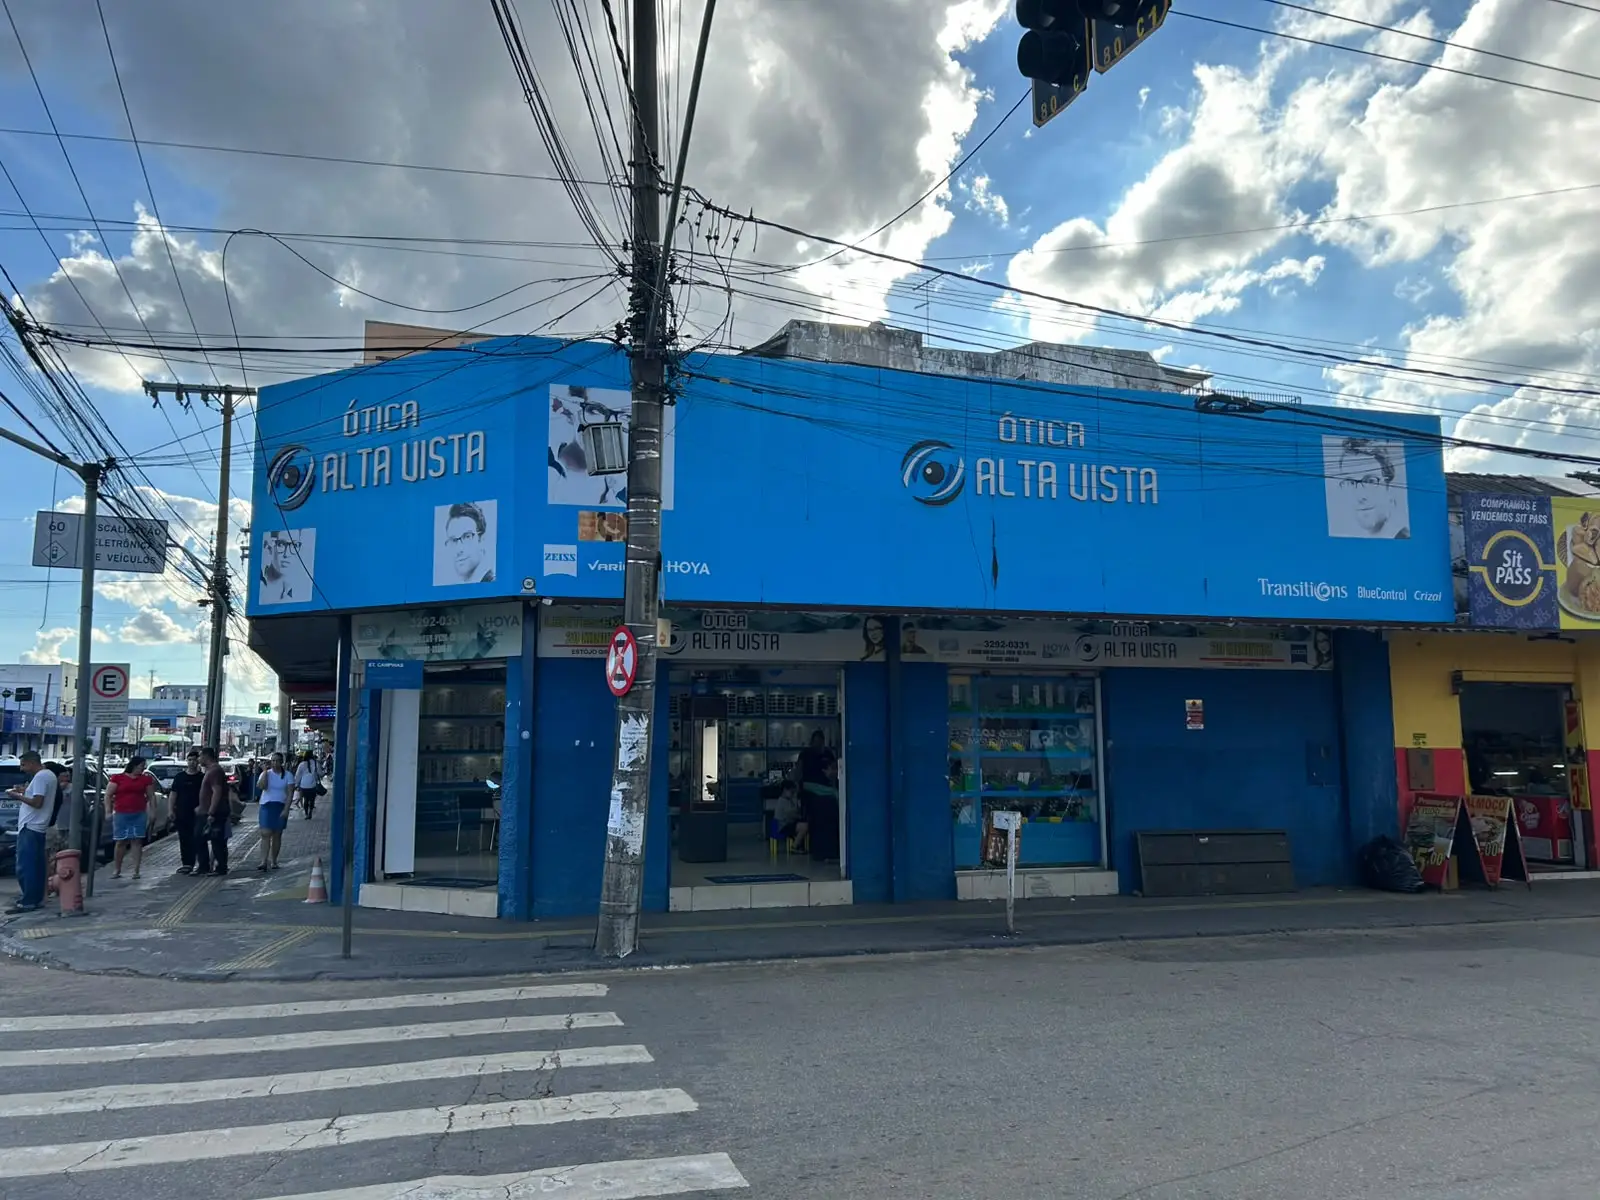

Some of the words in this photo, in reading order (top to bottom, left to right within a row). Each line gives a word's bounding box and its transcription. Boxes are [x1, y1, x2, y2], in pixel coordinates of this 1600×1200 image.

[343, 399, 420, 437] ÓTICA
[998, 411, 1085, 447] ÓTICA
[322, 445, 391, 493] ALTA
[401, 430, 486, 483] VISTA
[976, 457, 1057, 499] ALTA
[1069, 463, 1159, 504] VISTA
[1480, 498, 1530, 511] COMPRAMOS
[1532, 502, 1537, 511] E
[1471, 510, 1513, 523] VENDEMOS
[1515, 512, 1527, 523] SIT
[1528, 513, 1548, 525] PASS
[97, 523, 162, 536] SCALIZÃO
[95, 553, 102, 561] E
[107, 551, 157, 565] VEÍCULOS
[544, 553, 577, 562] ZEISS
[1502, 549, 1523, 569] Sit
[664, 560, 711, 575] HOYA
[1495, 567, 1532, 585] PASS
[1258, 578, 1348, 601] Transitions
[1357, 586, 1407, 601] BlueControl
[1414, 590, 1442, 602] Crizal
[484, 614, 520, 628] HOYA
[692, 632, 731, 650] ALTA
[737, 633, 780, 651] VISTA
[1104, 641, 1136, 658] ALTA
[1141, 642, 1177, 658] VISTA
[103, 675, 117, 692] E
